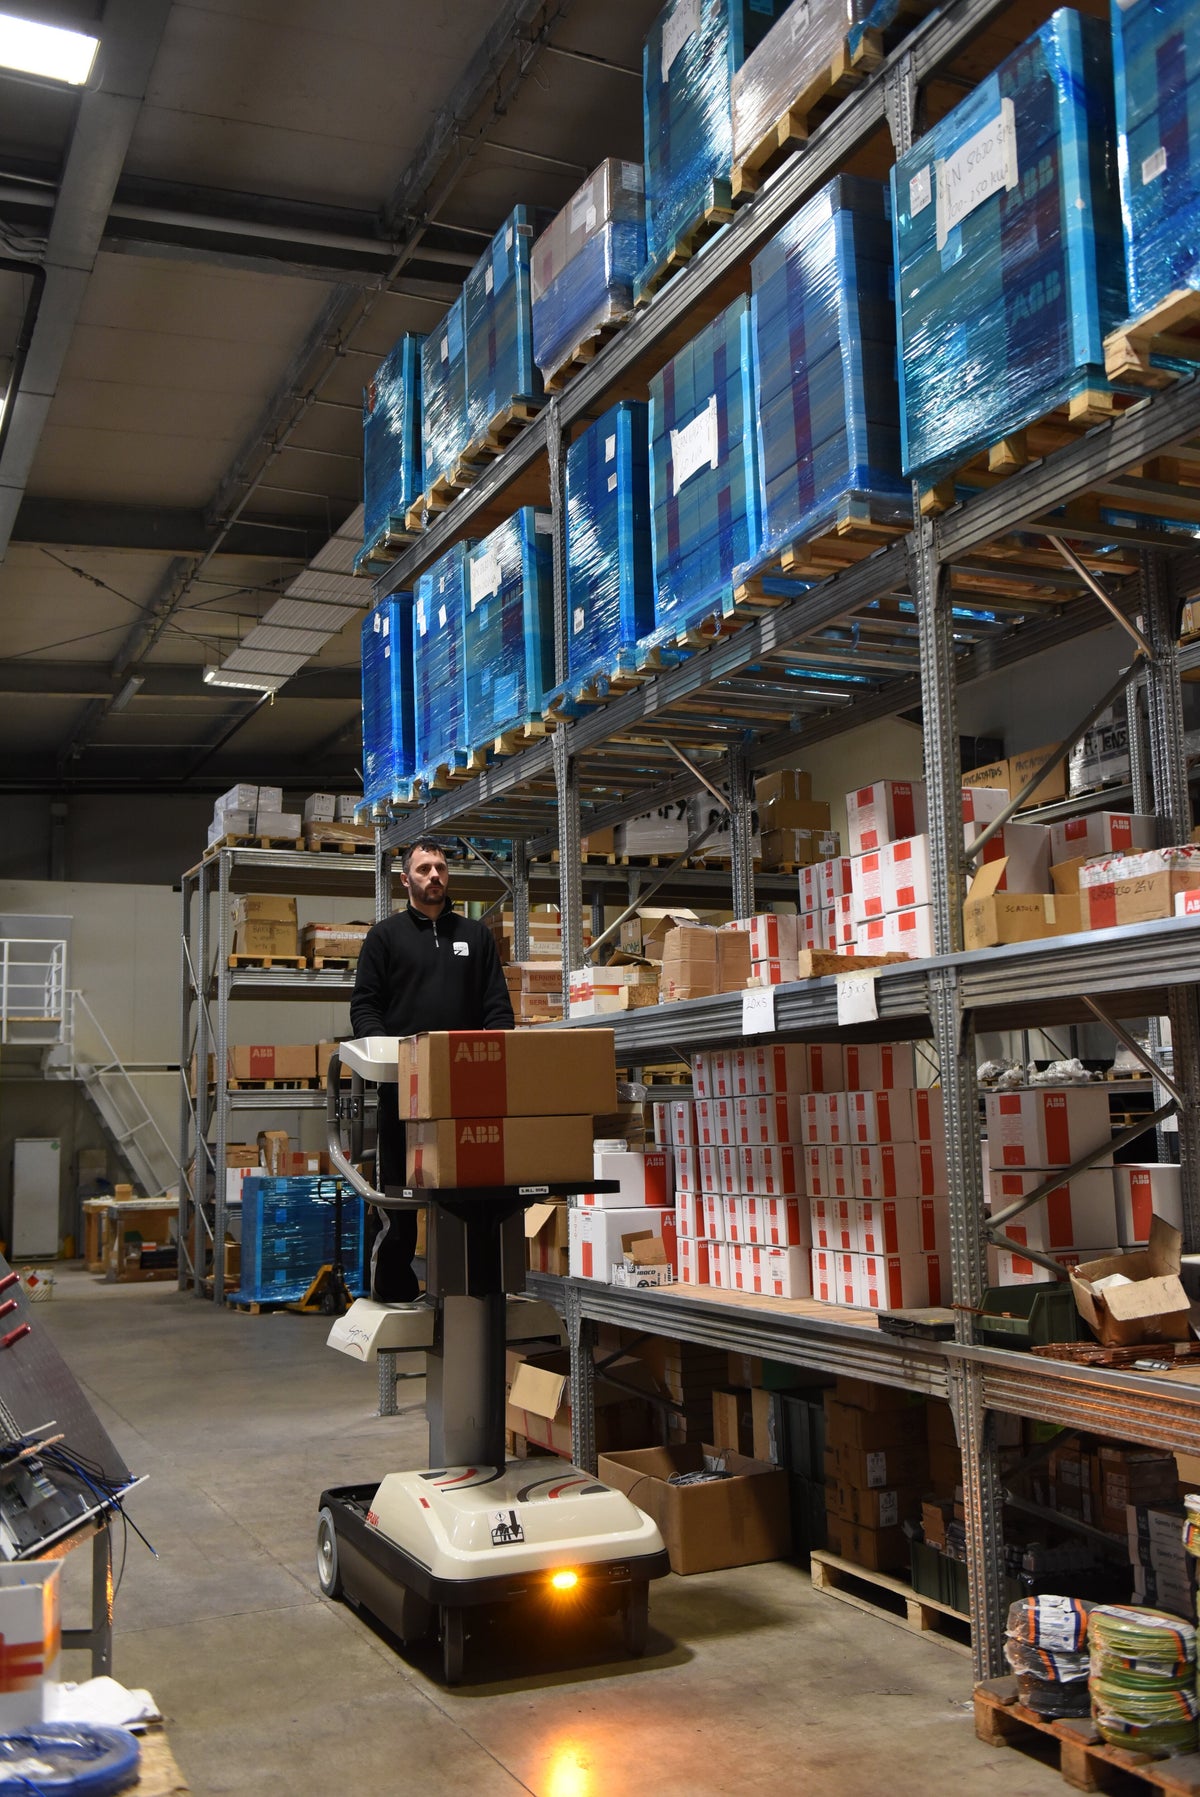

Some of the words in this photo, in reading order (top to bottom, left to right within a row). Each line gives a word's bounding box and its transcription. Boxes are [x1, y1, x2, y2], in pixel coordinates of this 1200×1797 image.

[1012, 270, 1061, 325] ABB
[1112, 819, 1129, 830] ABB
[252, 1048, 273, 1058] ABB
[454, 1042, 502, 1063] ABB
[1046, 1097, 1065, 1108] ABB
[459, 1125, 500, 1144] ABB
[646, 1157, 664, 1167] ABB
[1132, 1174, 1149, 1185] ABB
